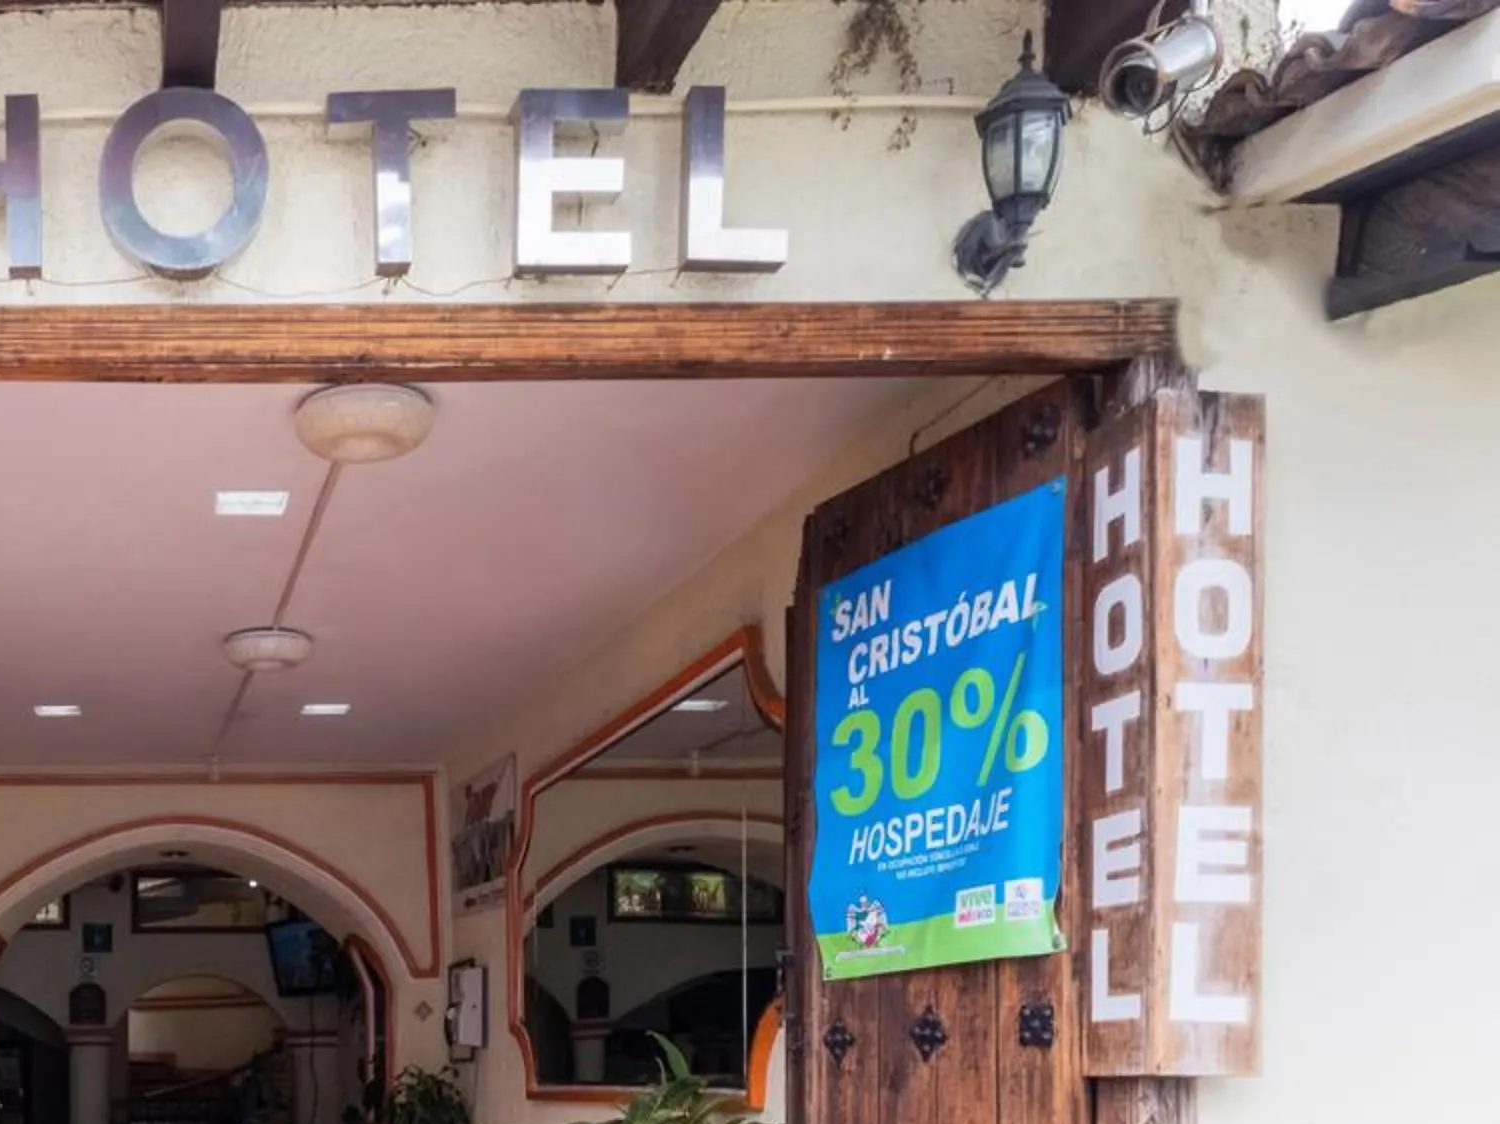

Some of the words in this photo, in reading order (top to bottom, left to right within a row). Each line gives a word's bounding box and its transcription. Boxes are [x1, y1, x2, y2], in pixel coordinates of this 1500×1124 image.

[831, 578, 893, 643] SAN
[847, 572, 1047, 685] CRISTÓBAL
[829, 652, 1049, 817] 30%
[848, 683, 870, 710] AL
[1091, 447, 1143, 1023] HOTEL
[1168, 437, 1255, 1024] HOTEL
[847, 787, 1013, 866] HOSPEDAJE
